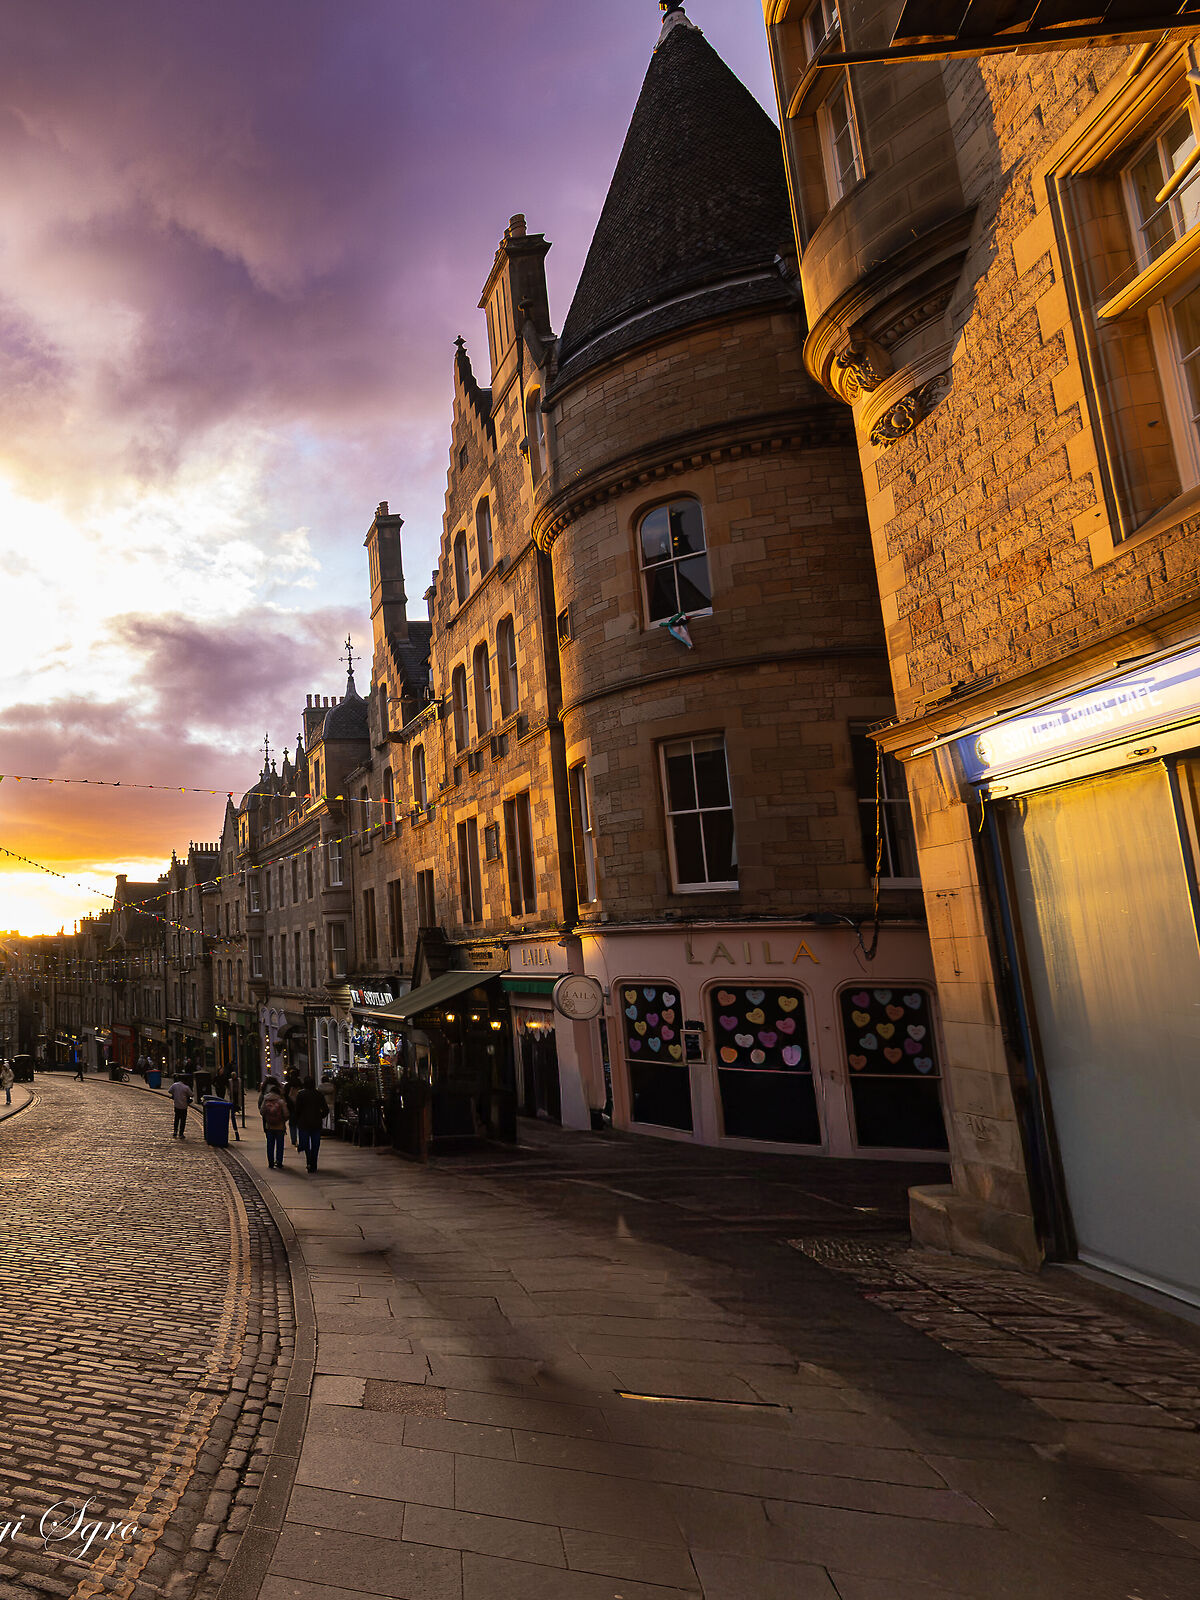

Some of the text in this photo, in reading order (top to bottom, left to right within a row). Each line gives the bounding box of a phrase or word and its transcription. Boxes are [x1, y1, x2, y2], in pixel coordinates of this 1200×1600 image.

[1070, 698, 1114, 732] CROSS
[521, 947, 550, 966] LAILA
[685, 939, 821, 965] LAILA
[565, 990, 597, 1000] LAILA
